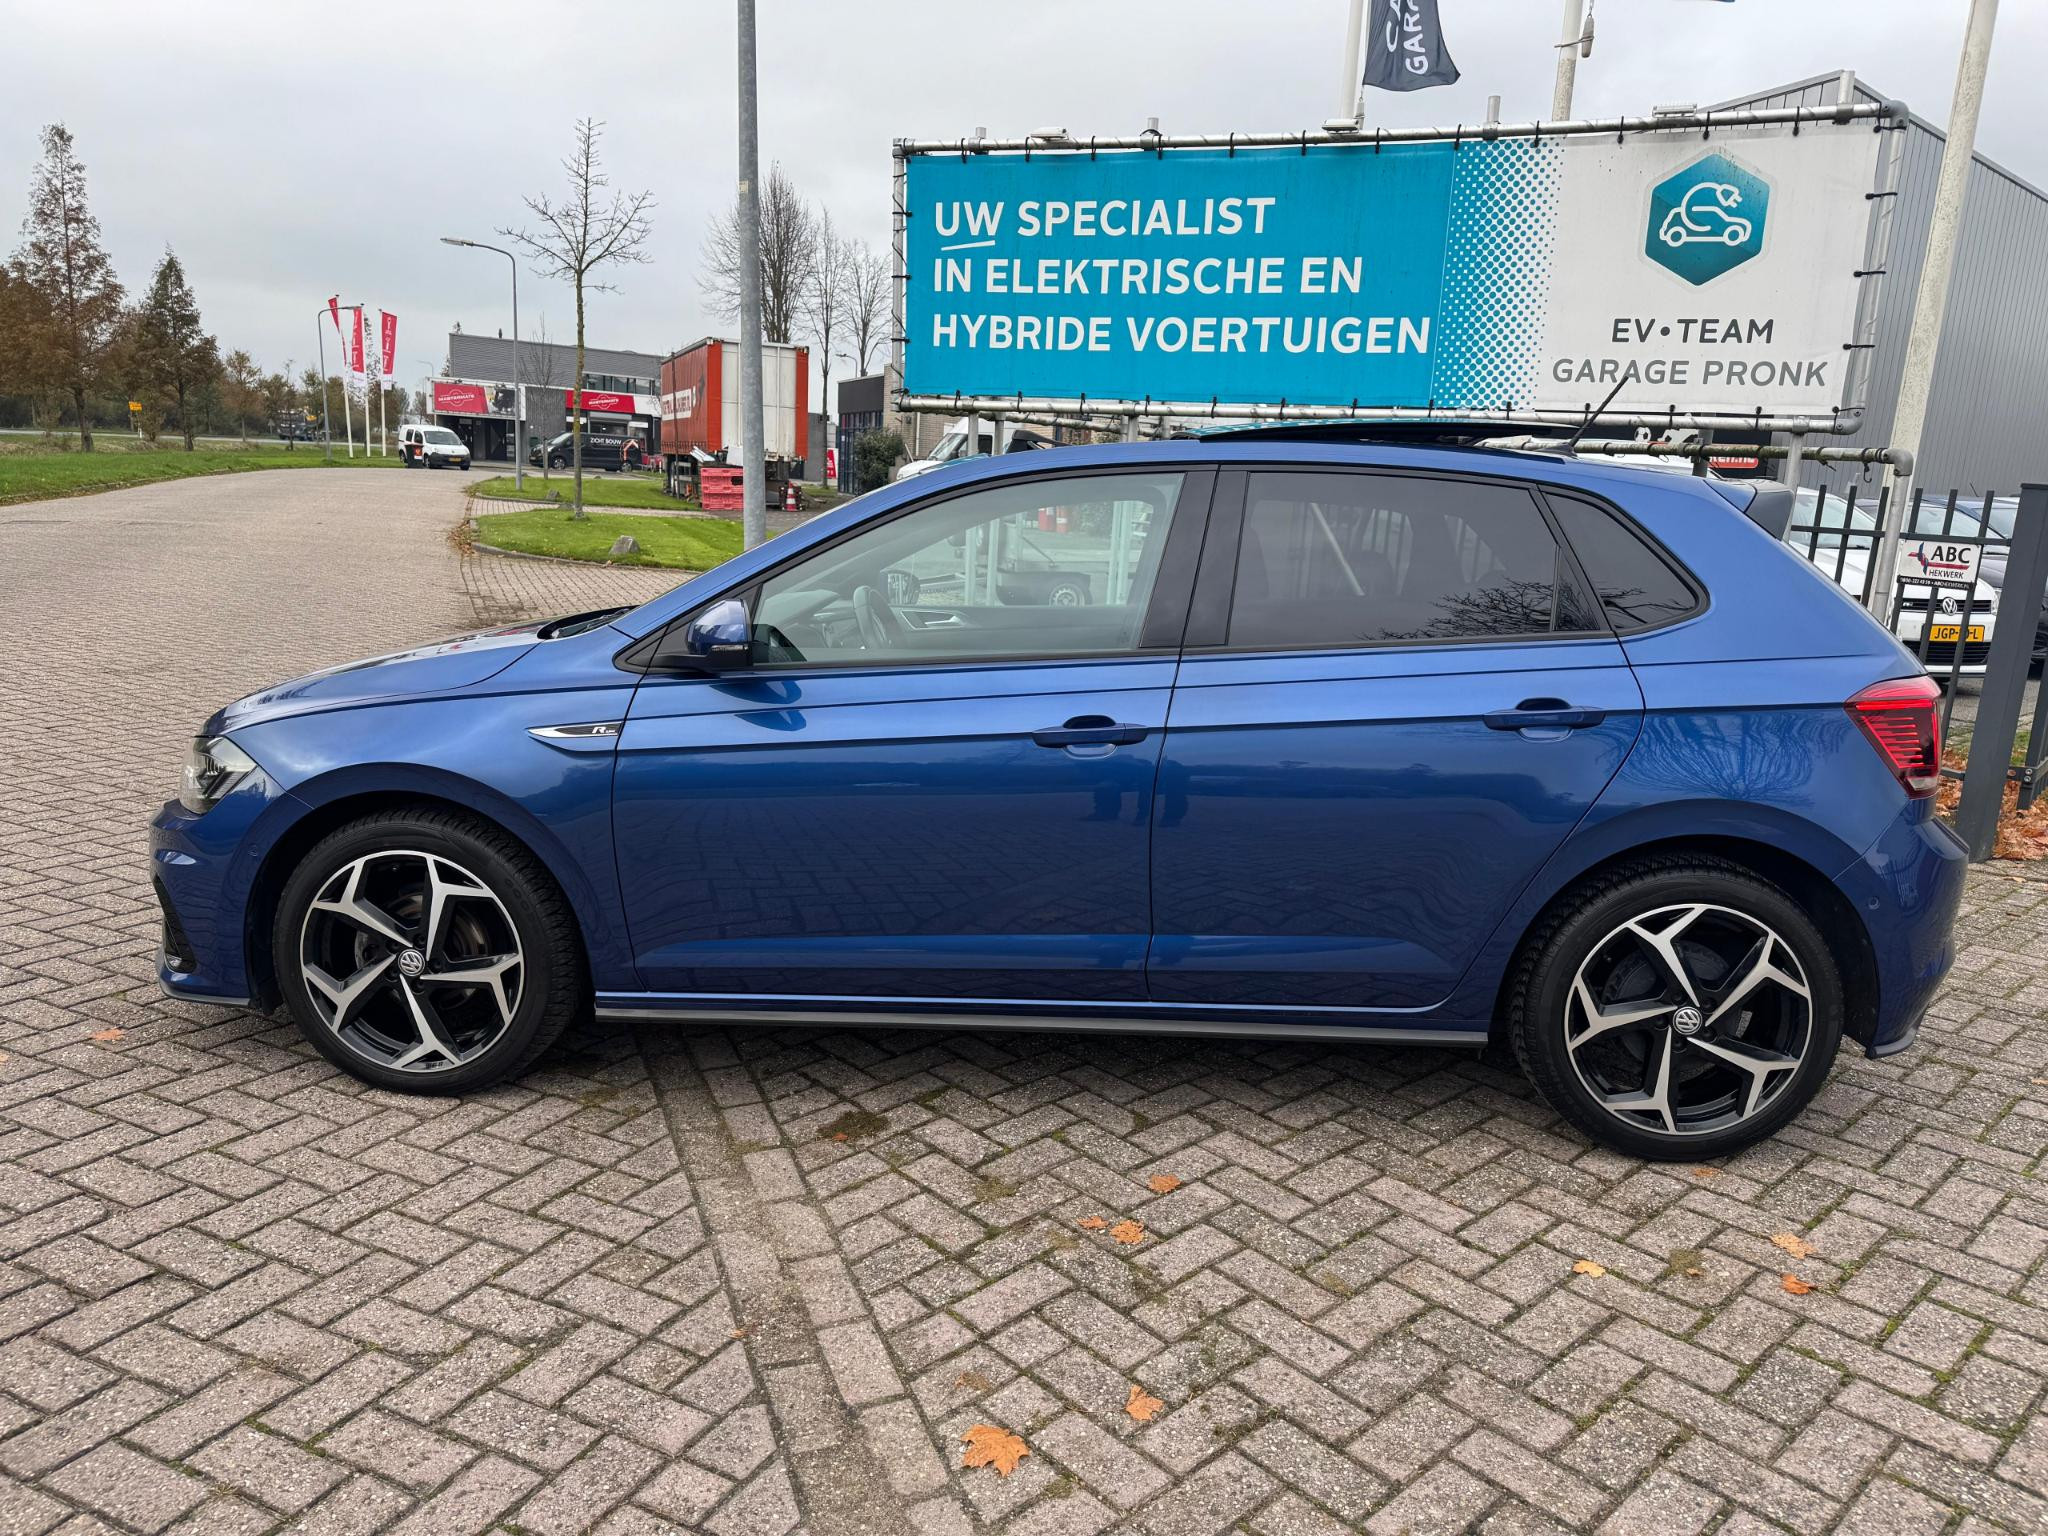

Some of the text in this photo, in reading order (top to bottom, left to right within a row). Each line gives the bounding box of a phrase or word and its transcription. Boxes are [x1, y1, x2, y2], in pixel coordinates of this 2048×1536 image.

[935, 197, 1276, 237] UW SPECIALIST
[934, 256, 1363, 295] IN ELEKTRISCHE EN
[933, 313, 1430, 354] HYBRIDE VOERTUIGEN
[1552, 358, 1828, 387] GARAGE PRONK
[1931, 545, 1971, 564] ABC
[1929, 569, 1964, 579] HEKWERK
[1934, 627, 1978, 640] JGP--L
